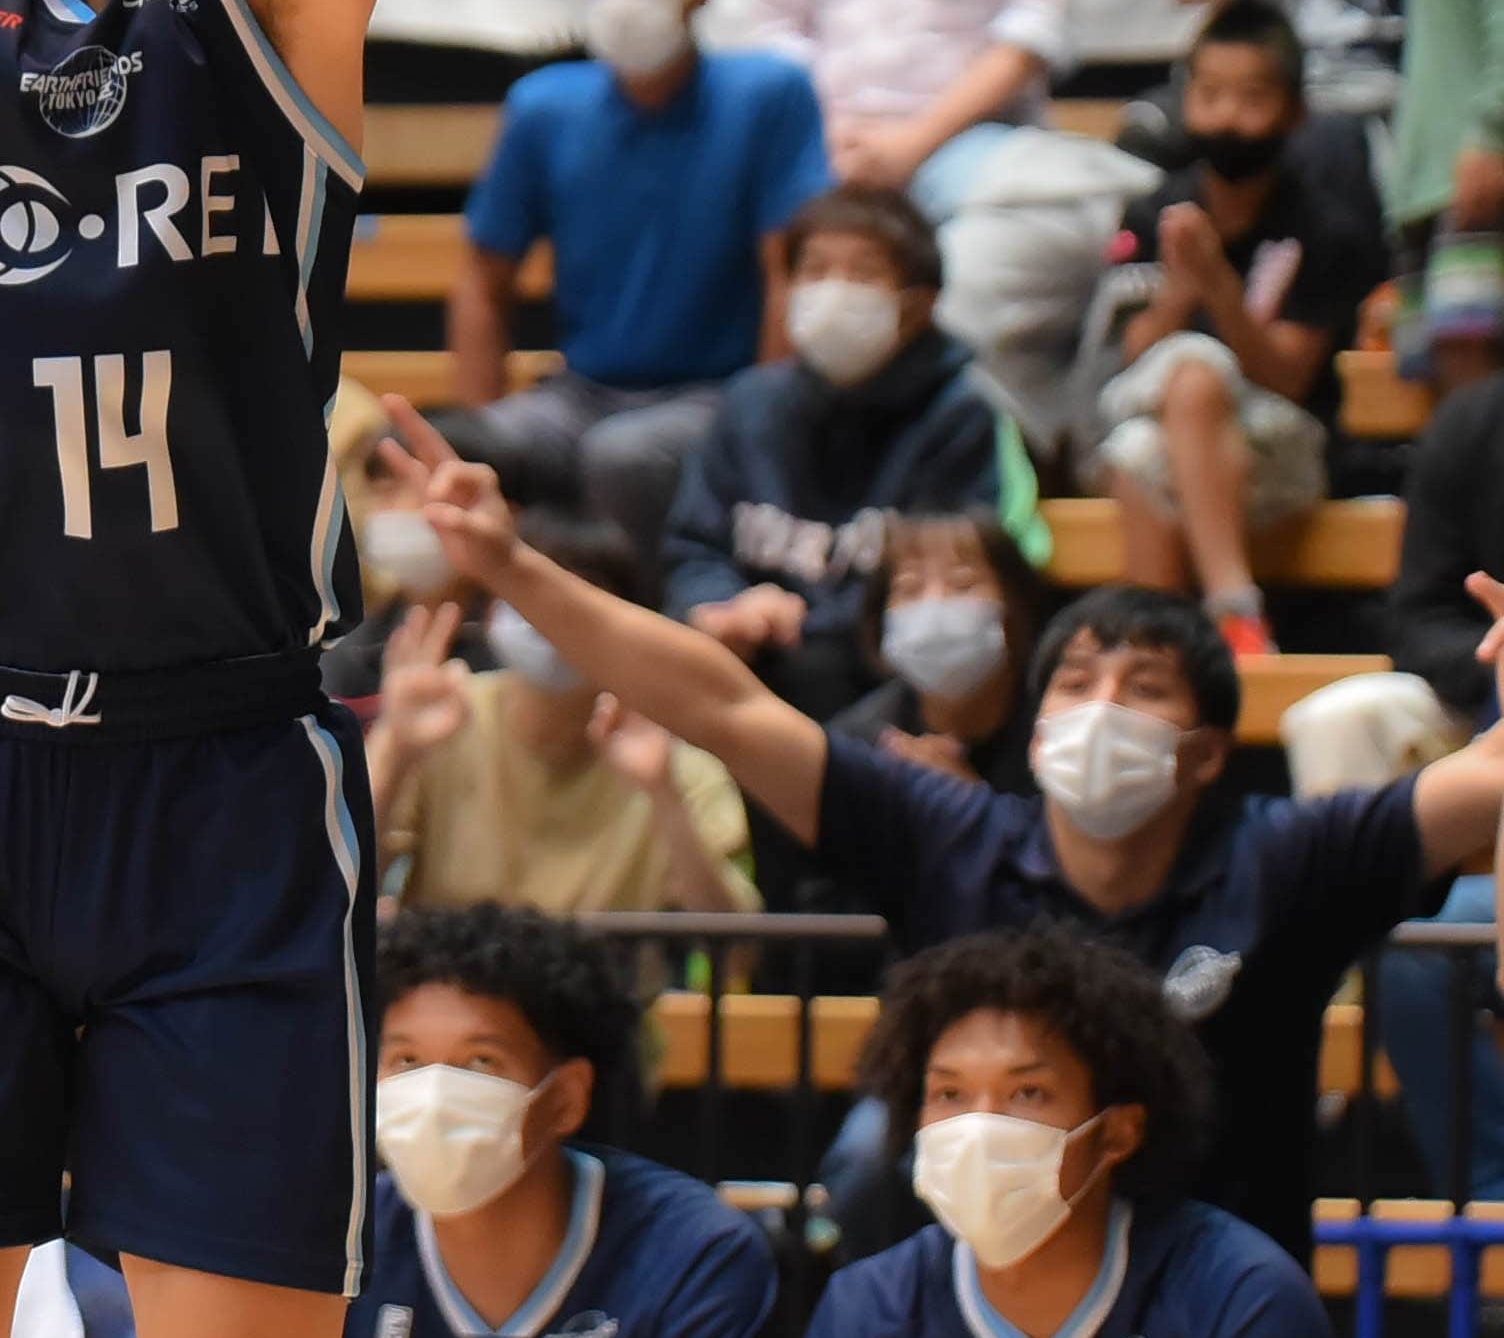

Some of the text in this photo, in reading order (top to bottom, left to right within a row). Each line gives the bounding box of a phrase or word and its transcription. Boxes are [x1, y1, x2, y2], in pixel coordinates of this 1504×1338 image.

[19, 50, 144, 94] EARTHFRIENDS
[47, 89, 97, 111] TOKYO
[33, 349, 180, 540] 14
